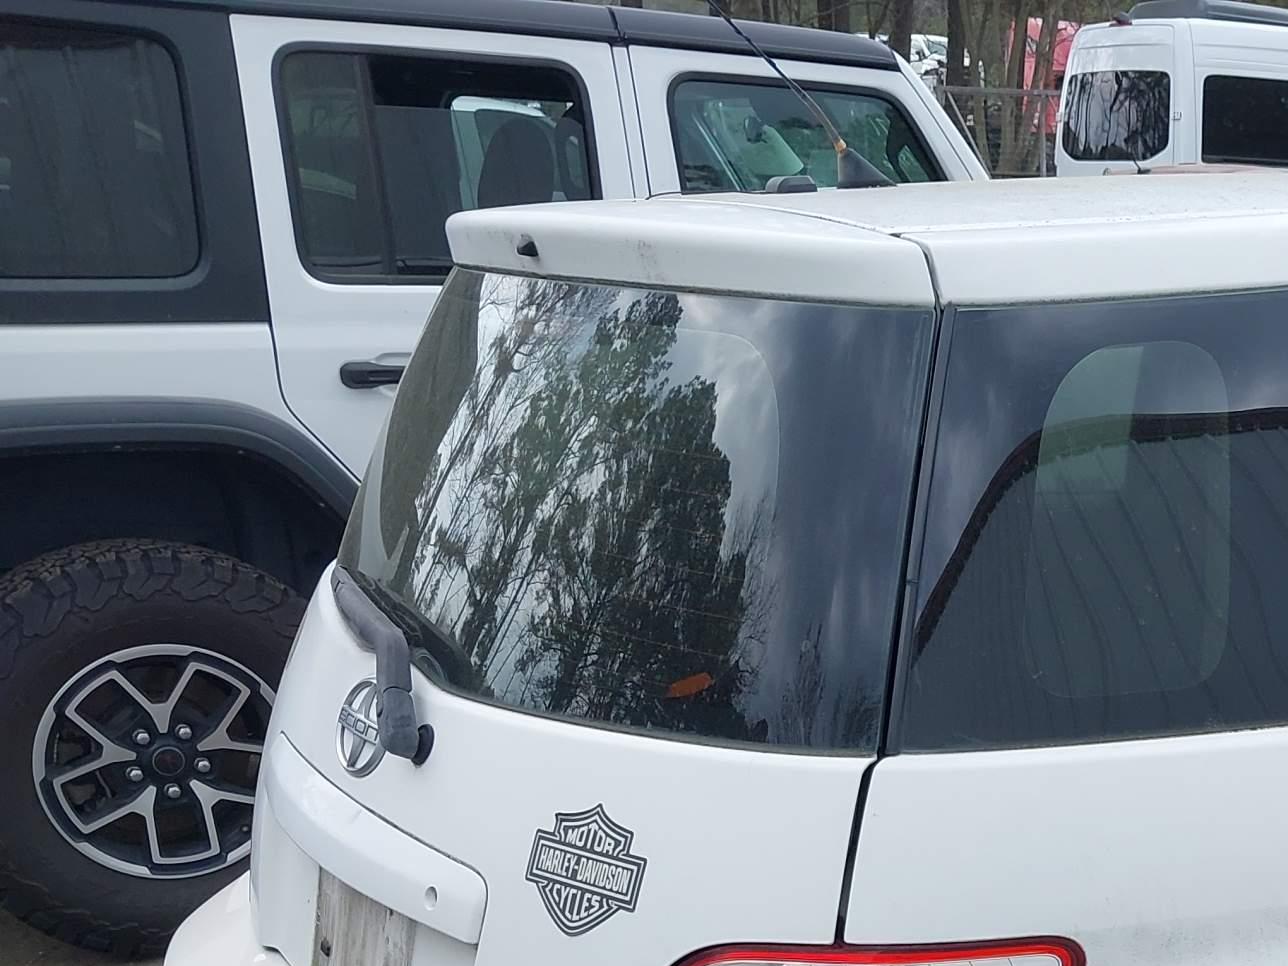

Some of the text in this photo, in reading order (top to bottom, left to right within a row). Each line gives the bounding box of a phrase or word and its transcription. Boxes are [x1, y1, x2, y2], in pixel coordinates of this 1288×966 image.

[566, 822, 616, 856] MOTOR
[538, 846, 632, 894] HARLEY-DAVIDSON
[552, 883, 601, 921] CYCLES
